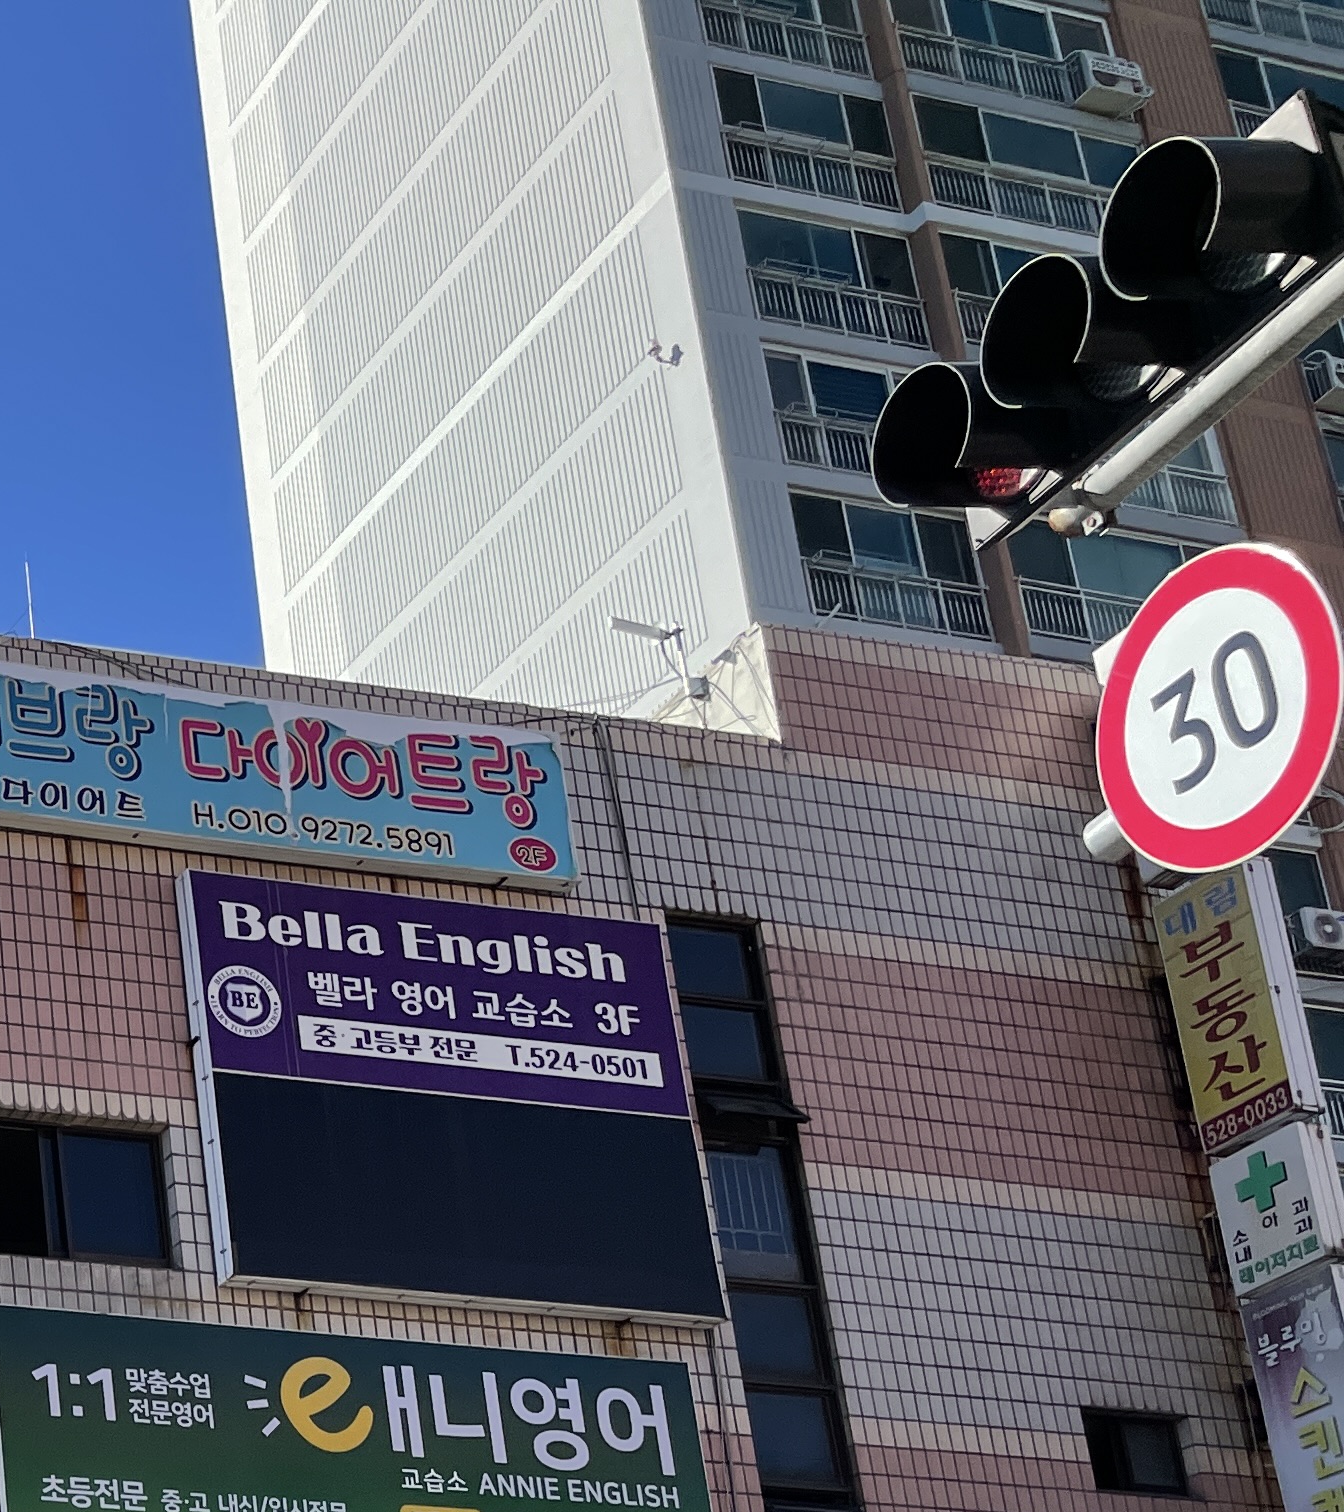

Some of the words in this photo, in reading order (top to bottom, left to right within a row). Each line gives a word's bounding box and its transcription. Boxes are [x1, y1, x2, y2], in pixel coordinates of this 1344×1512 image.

[1150, 630, 1279, 796] 30
[179, 716, 549, 831] 다이어트랑
[1163, 877, 1238, 936] 대림
[218, 900, 384, 958] Bella
[399, 919, 626, 985] English
[230, 990, 259, 1009] BE
[307, 971, 377, 1013] 벨라
[392, 979, 456, 1020] 영어
[472, 990, 574, 1031] 교습소
[597, 1004, 640, 1035] 3F
[1180, 920, 1267, 1101] 부동산
[428, 1033, 478, 1063] 전문
[506, 1043, 648, 1081] T.524-0501
[1206, 1087, 1289, 1147] 528-0033
[31, 1362, 118, 1421] 1:1
[125, 1368, 211, 1398] 맞춤수업
[128, 1399, 215, 1430] 전문영어
[402, 1467, 469, 1495] 교습소
[479, 1473, 561, 1502] ANNIE
[568, 1480, 679, 1510] ENGLISH
